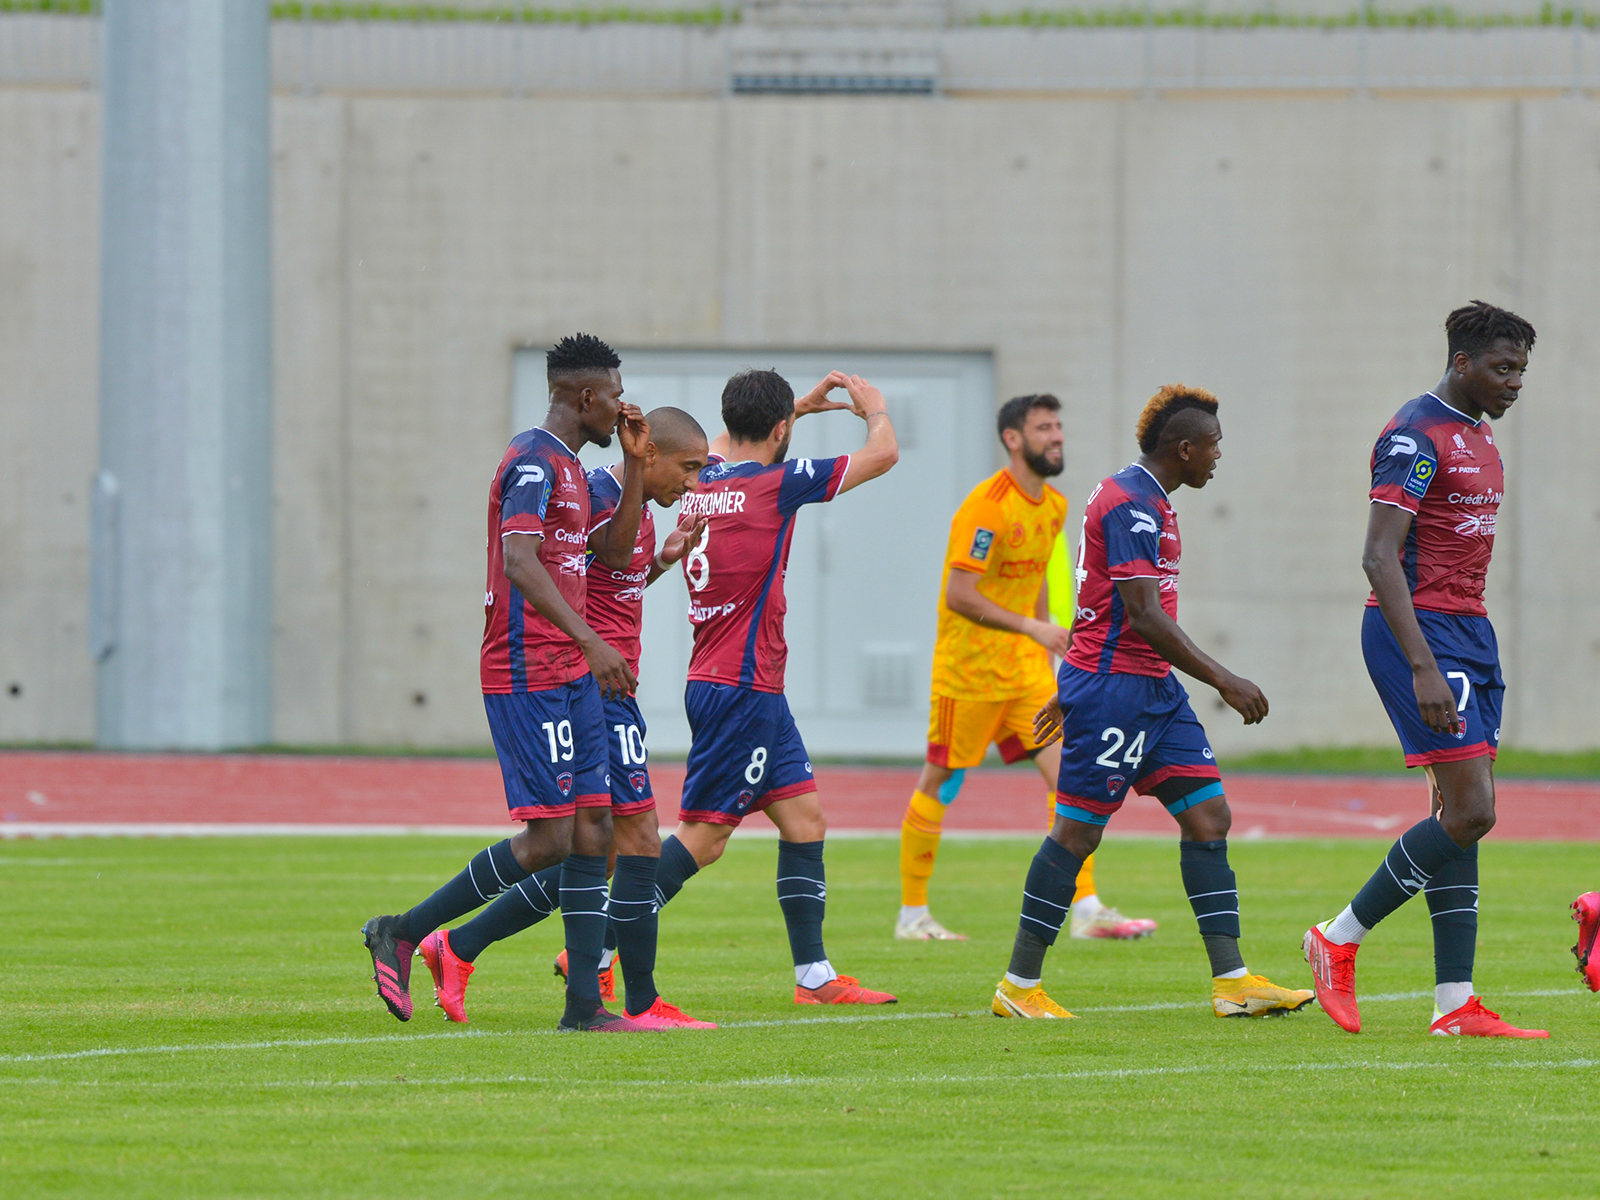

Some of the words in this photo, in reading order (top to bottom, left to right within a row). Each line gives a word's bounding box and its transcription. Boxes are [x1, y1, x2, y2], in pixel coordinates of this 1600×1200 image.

[1447, 492, 1484, 505] Crédit
[686, 522, 710, 592] 8
[1446, 671, 1470, 712] 7
[541, 719, 574, 764] 19
[613, 724, 647, 765] 10
[1095, 727, 1146, 769] 24
[744, 746, 767, 785] 8
